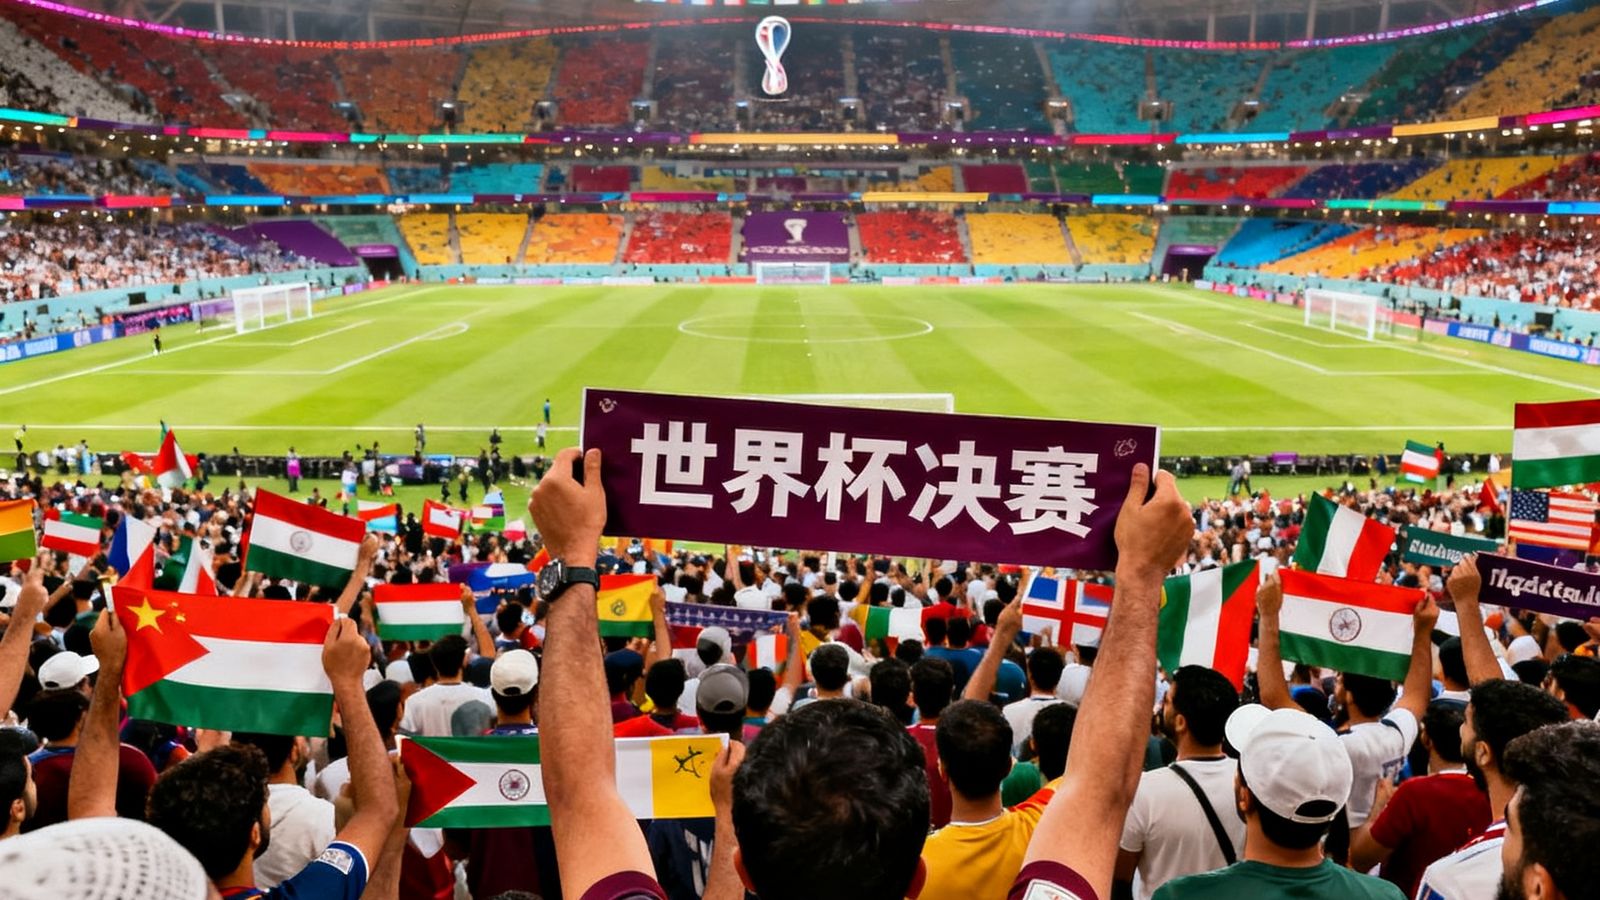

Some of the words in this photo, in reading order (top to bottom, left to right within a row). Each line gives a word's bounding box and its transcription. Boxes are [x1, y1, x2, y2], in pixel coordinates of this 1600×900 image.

[630, 420, 1099, 538] 世界杯决赛
